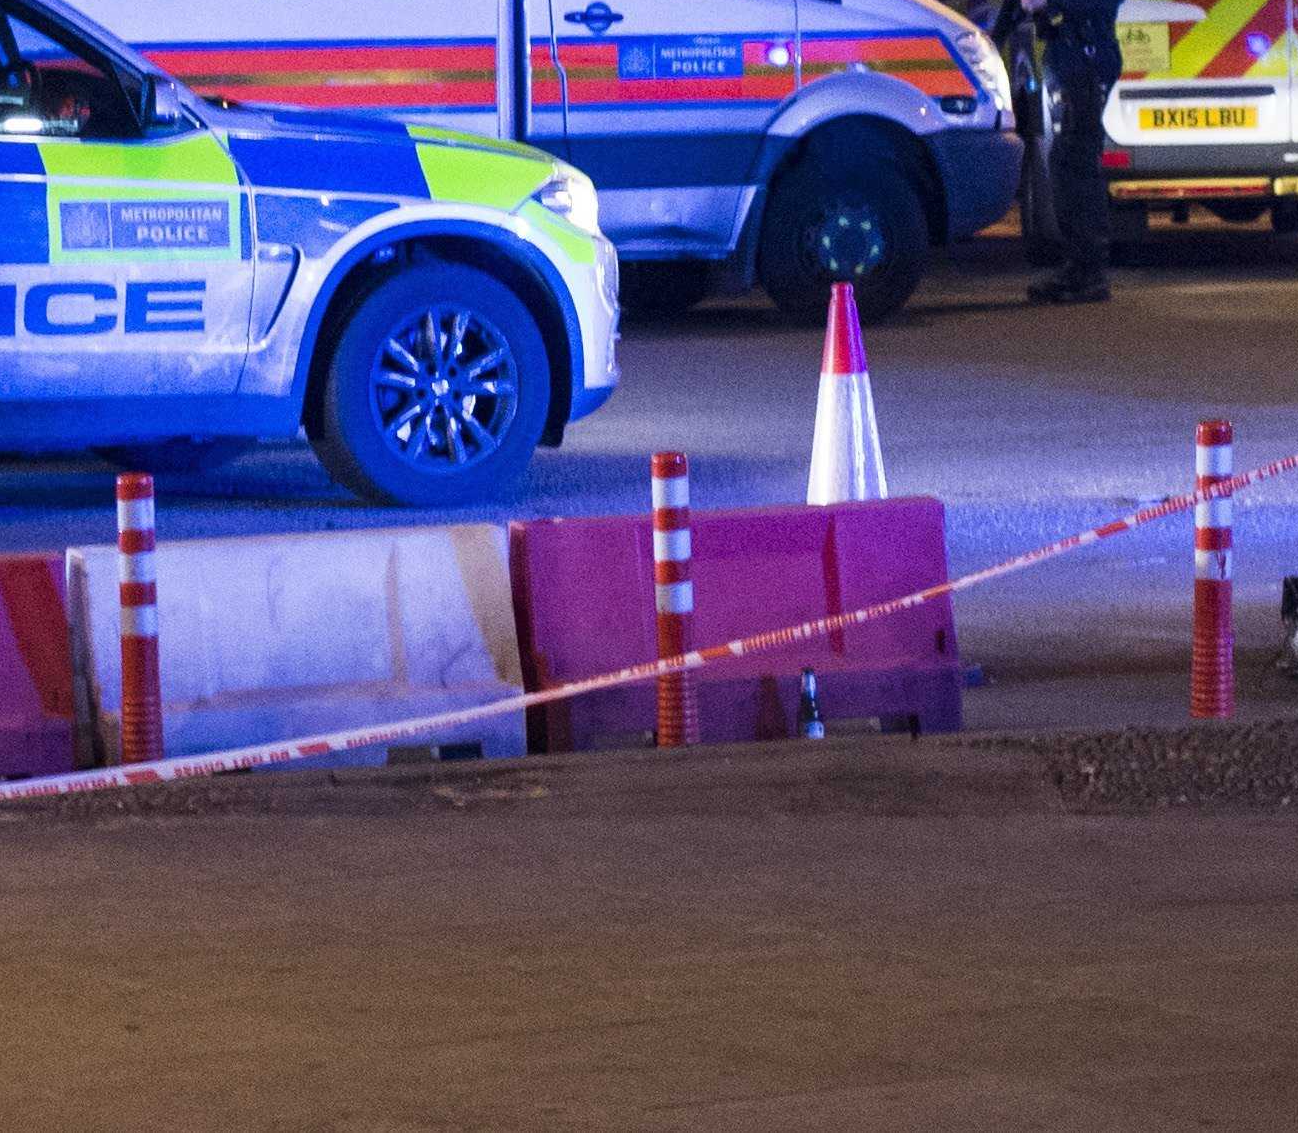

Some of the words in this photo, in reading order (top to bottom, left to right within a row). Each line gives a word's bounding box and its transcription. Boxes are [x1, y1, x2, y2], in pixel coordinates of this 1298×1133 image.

[660, 45, 737, 59] METROPOLITAN
[671, 60, 726, 74] POLICE
[120, 206, 223, 222] METROPOLITAN
[136, 224, 209, 244] POLICE
